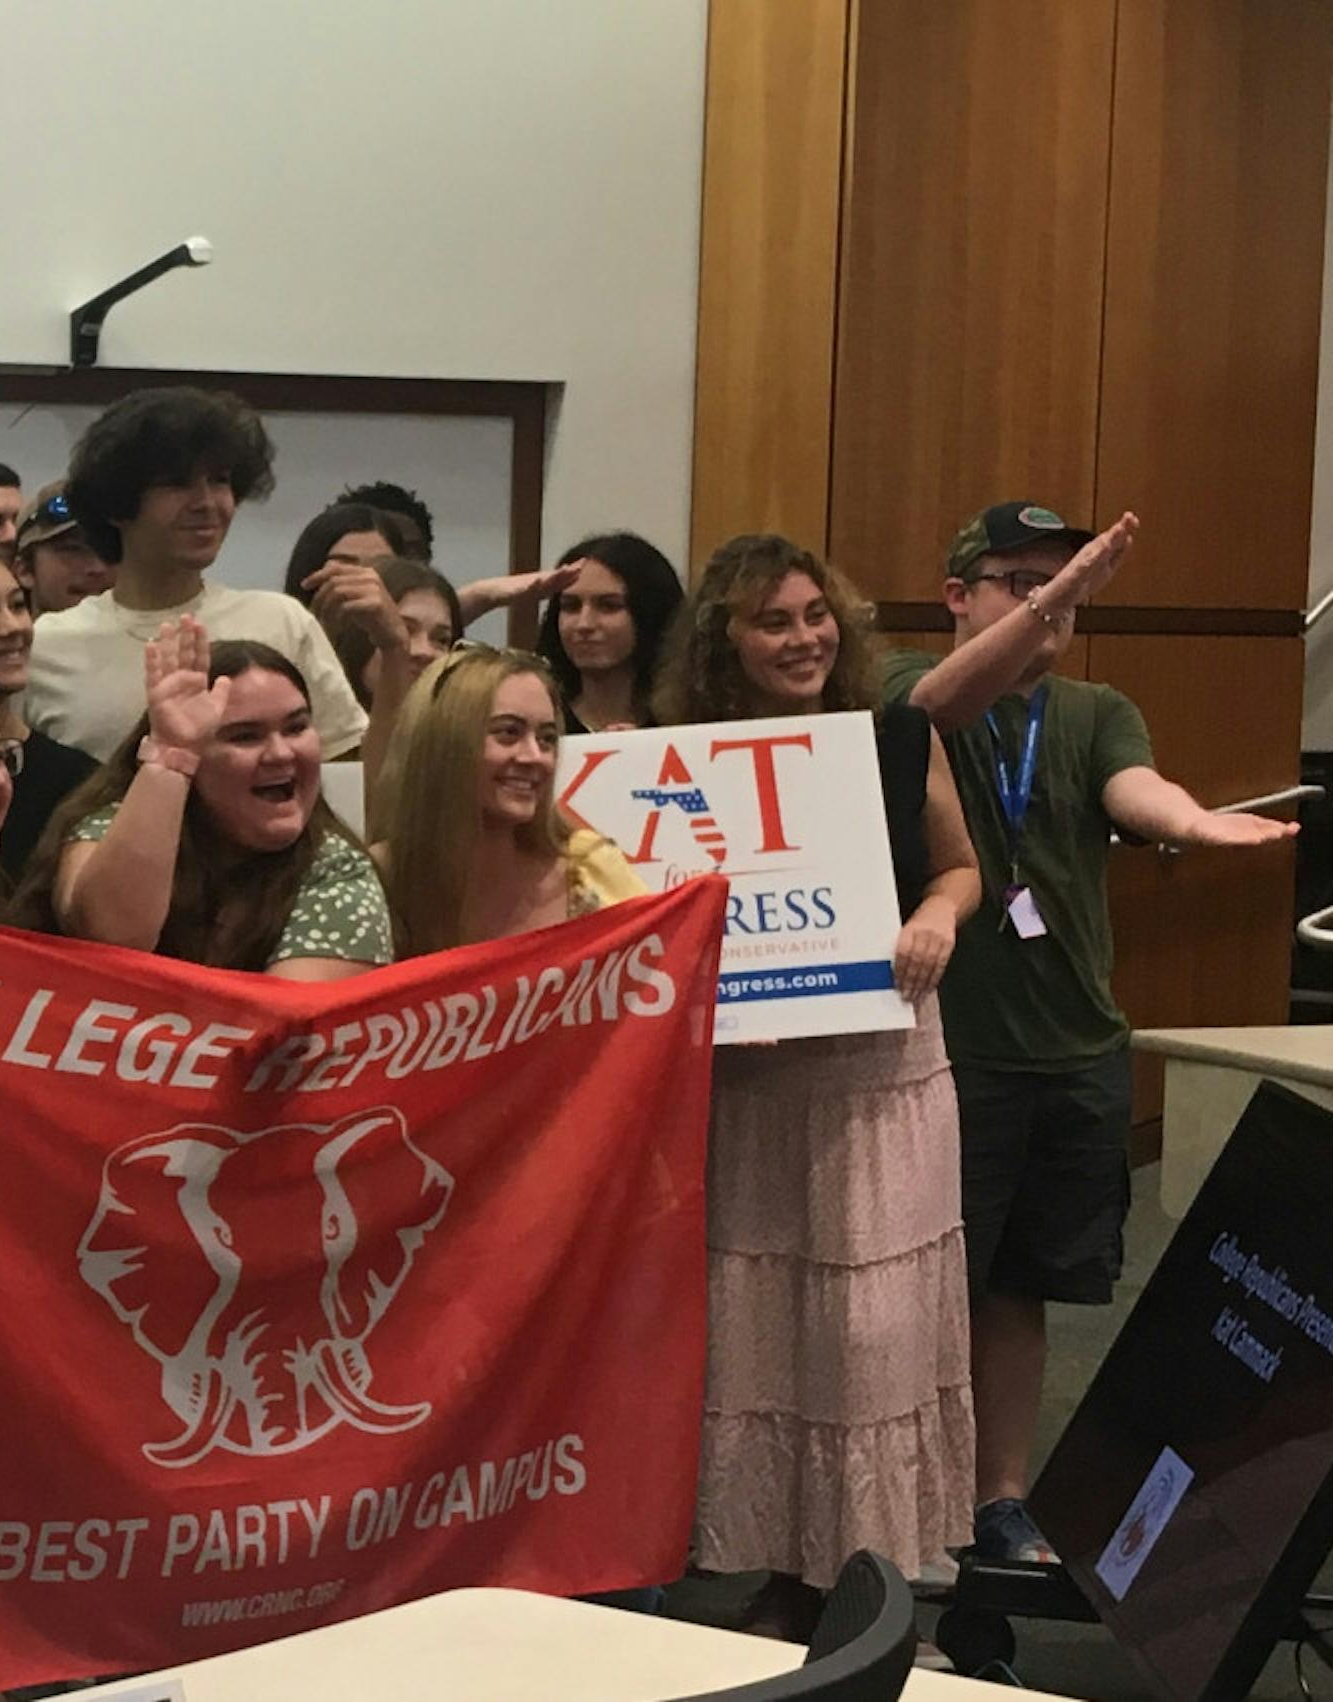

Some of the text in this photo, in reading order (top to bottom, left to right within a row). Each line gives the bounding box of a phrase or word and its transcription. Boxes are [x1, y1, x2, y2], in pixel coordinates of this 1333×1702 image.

[722, 938, 840, 960] ONSERVATIVE
[724, 887, 836, 936] RESS
[245, 933, 677, 1094] REPUBLICANS
[160, 1495, 332, 1578] PARTY
[345, 1484, 412, 1551] ON
[414, 1435, 587, 1533] CAMPUS
